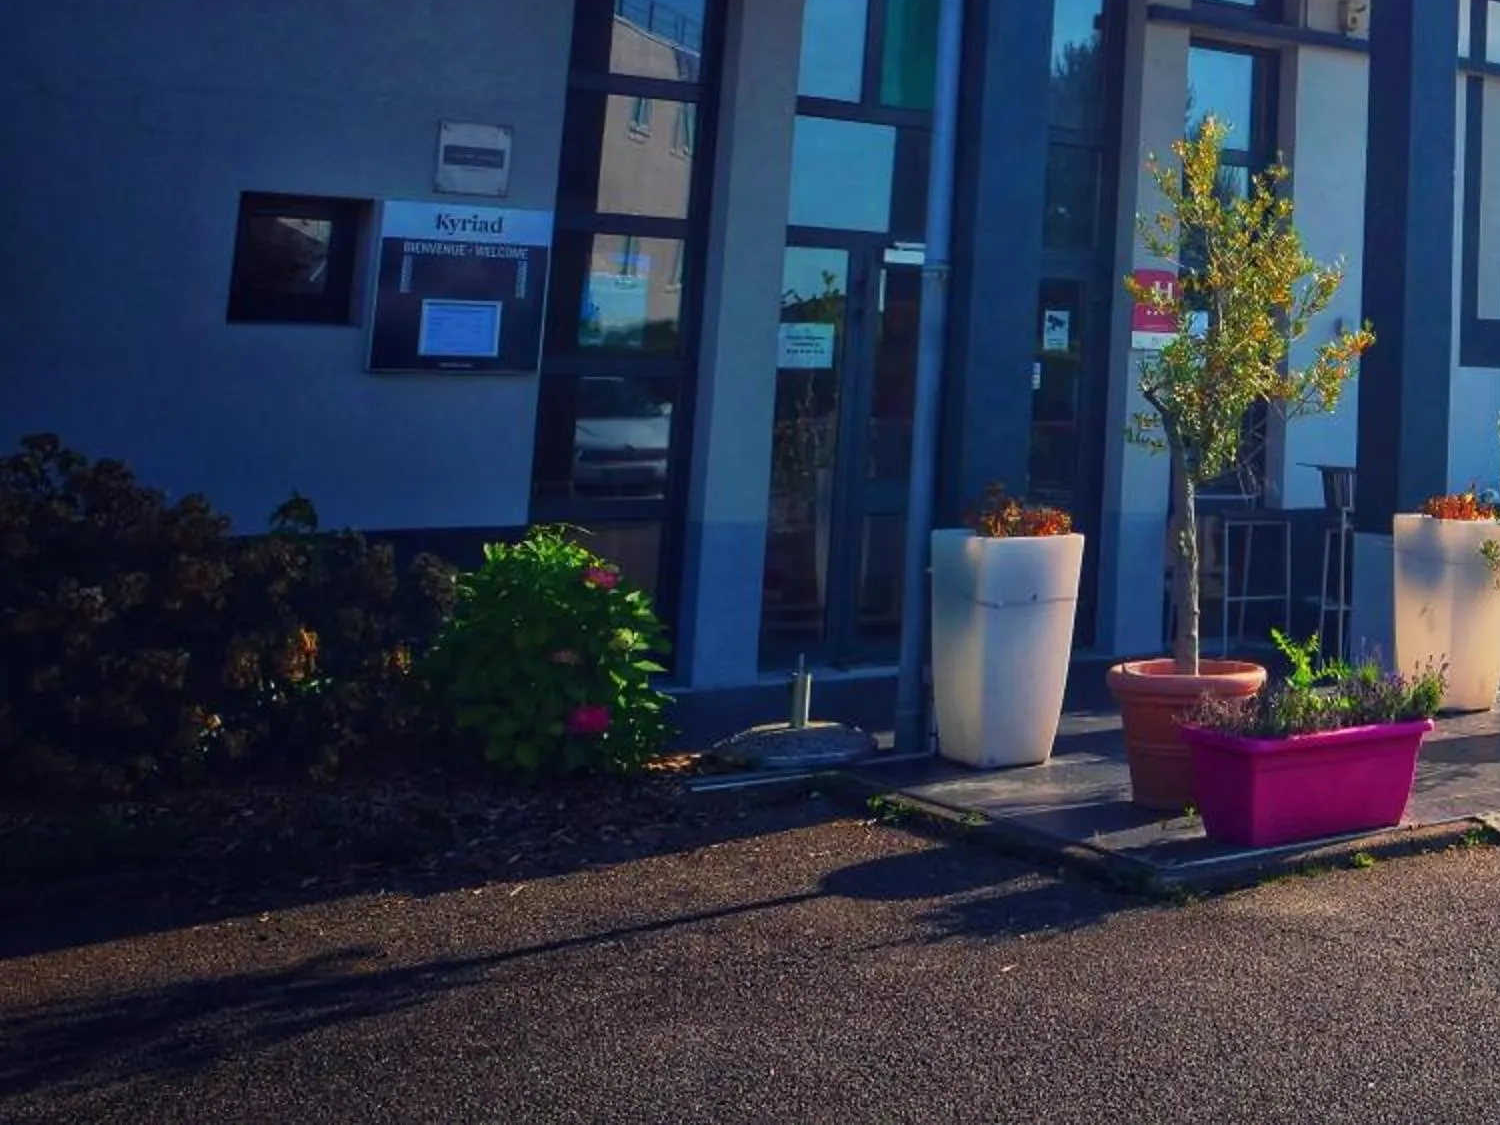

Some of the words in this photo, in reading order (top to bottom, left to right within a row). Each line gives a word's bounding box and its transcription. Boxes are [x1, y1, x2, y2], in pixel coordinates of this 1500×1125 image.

[435, 213, 504, 235] Kyriad
[403, 241, 466, 257] BIENVENUE
[475, 245, 529, 260] WELCOME
